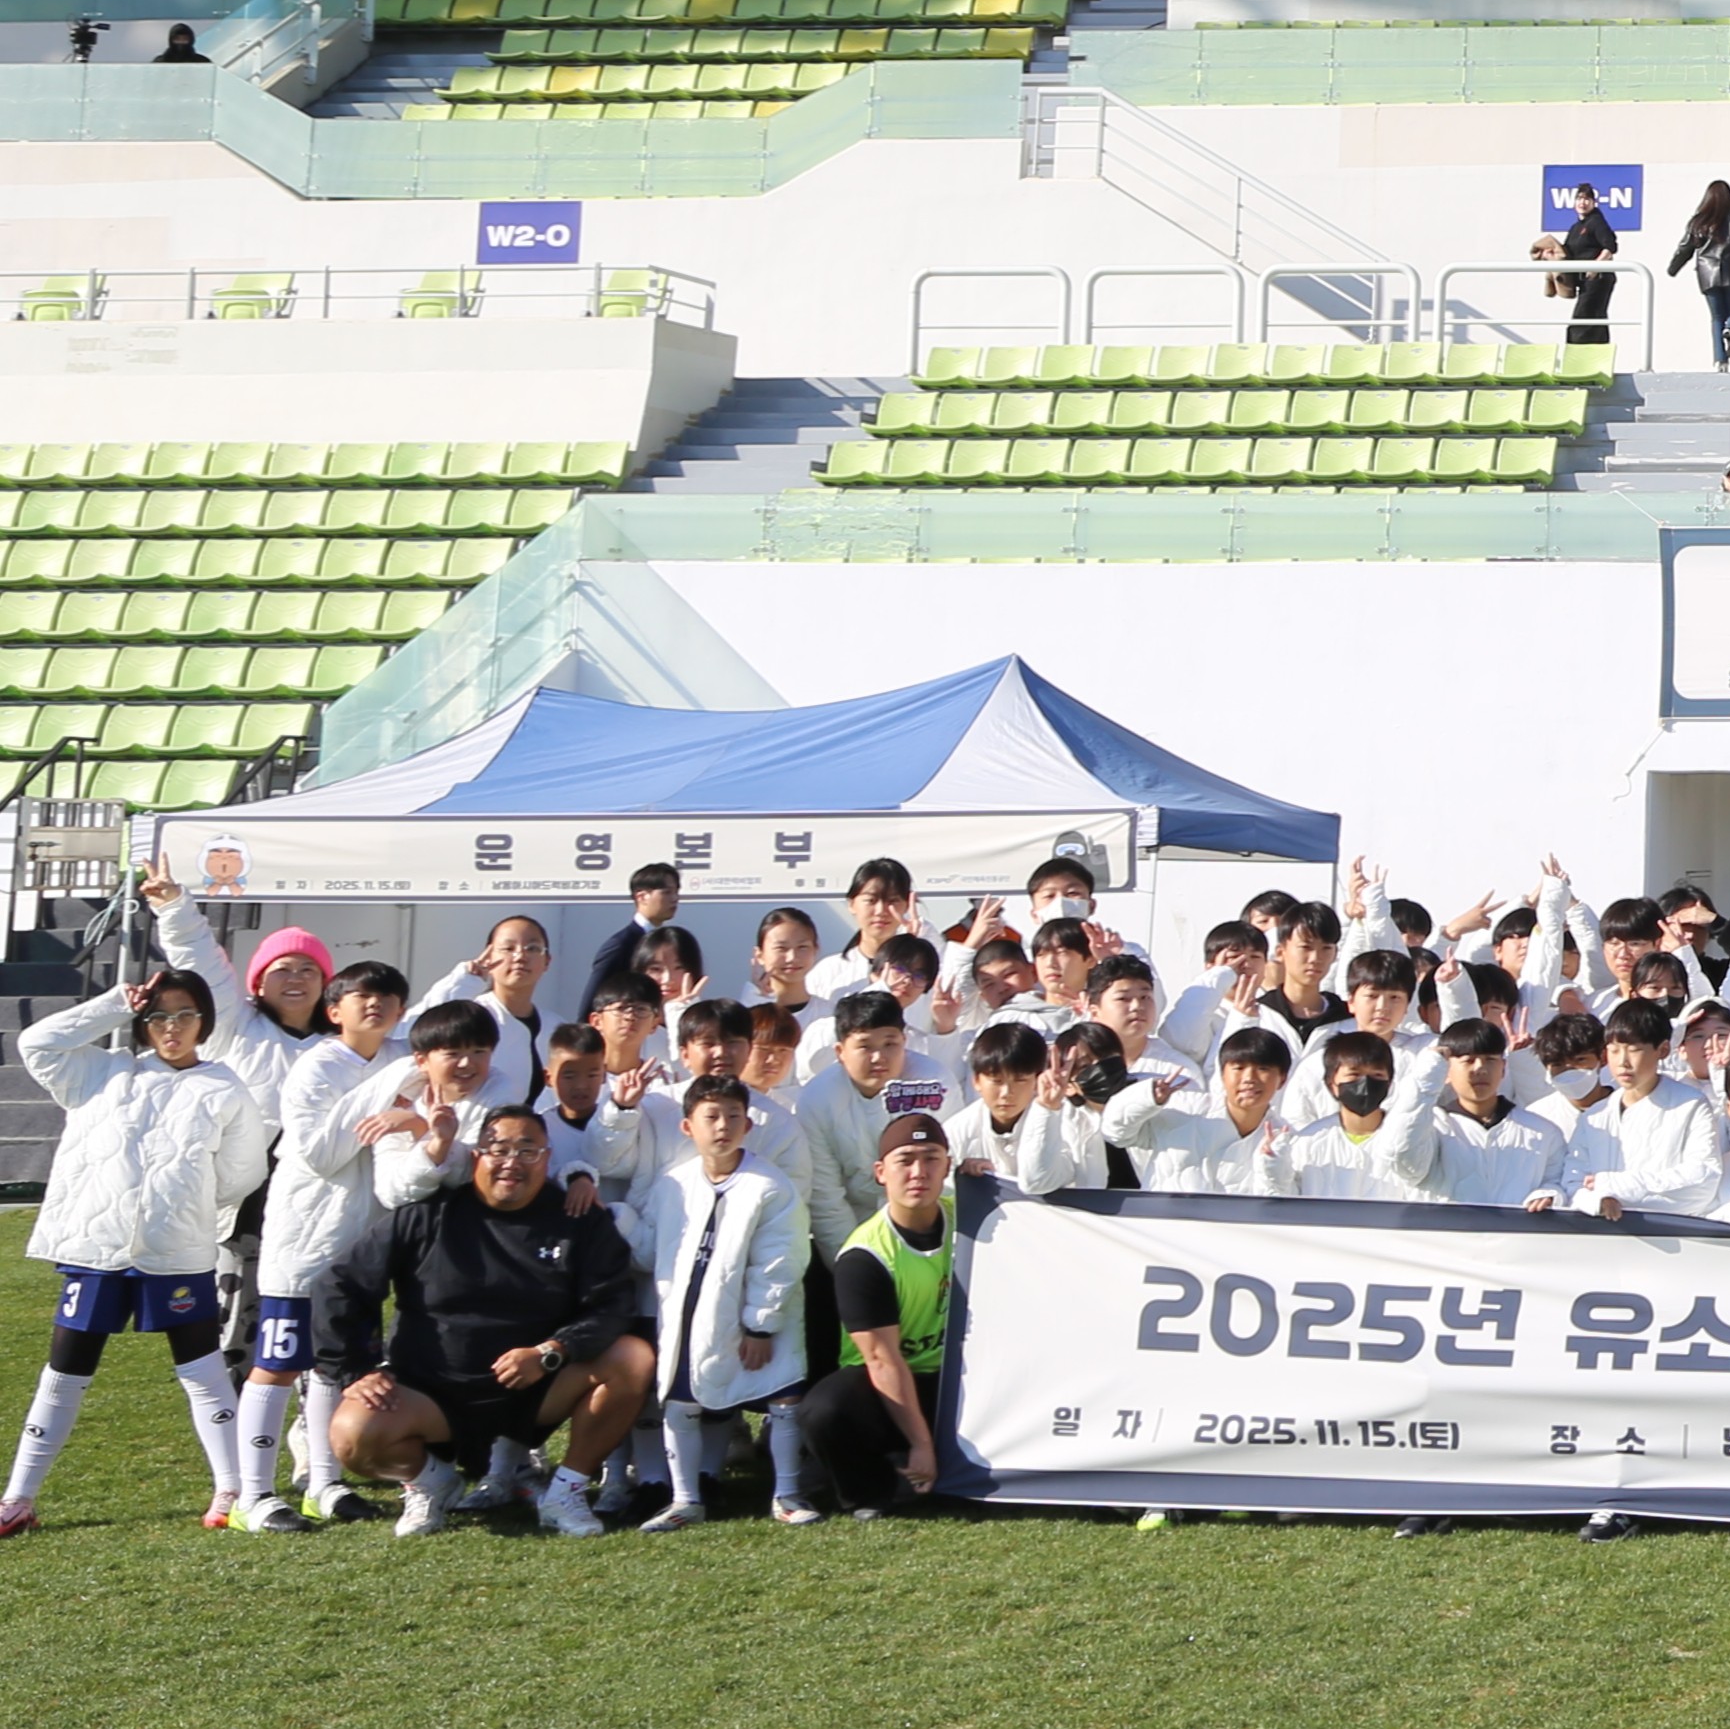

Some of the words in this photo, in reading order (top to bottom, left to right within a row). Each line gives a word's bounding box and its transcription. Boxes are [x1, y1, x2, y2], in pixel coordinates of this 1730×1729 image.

[1550, 187, 1632, 209] W-N
[486, 224, 571, 248] W2-O
[63, 1282, 82, 1318] 3
[1137, 1265, 1523, 1368] 2025년
[261, 1318, 299, 1359] 15
